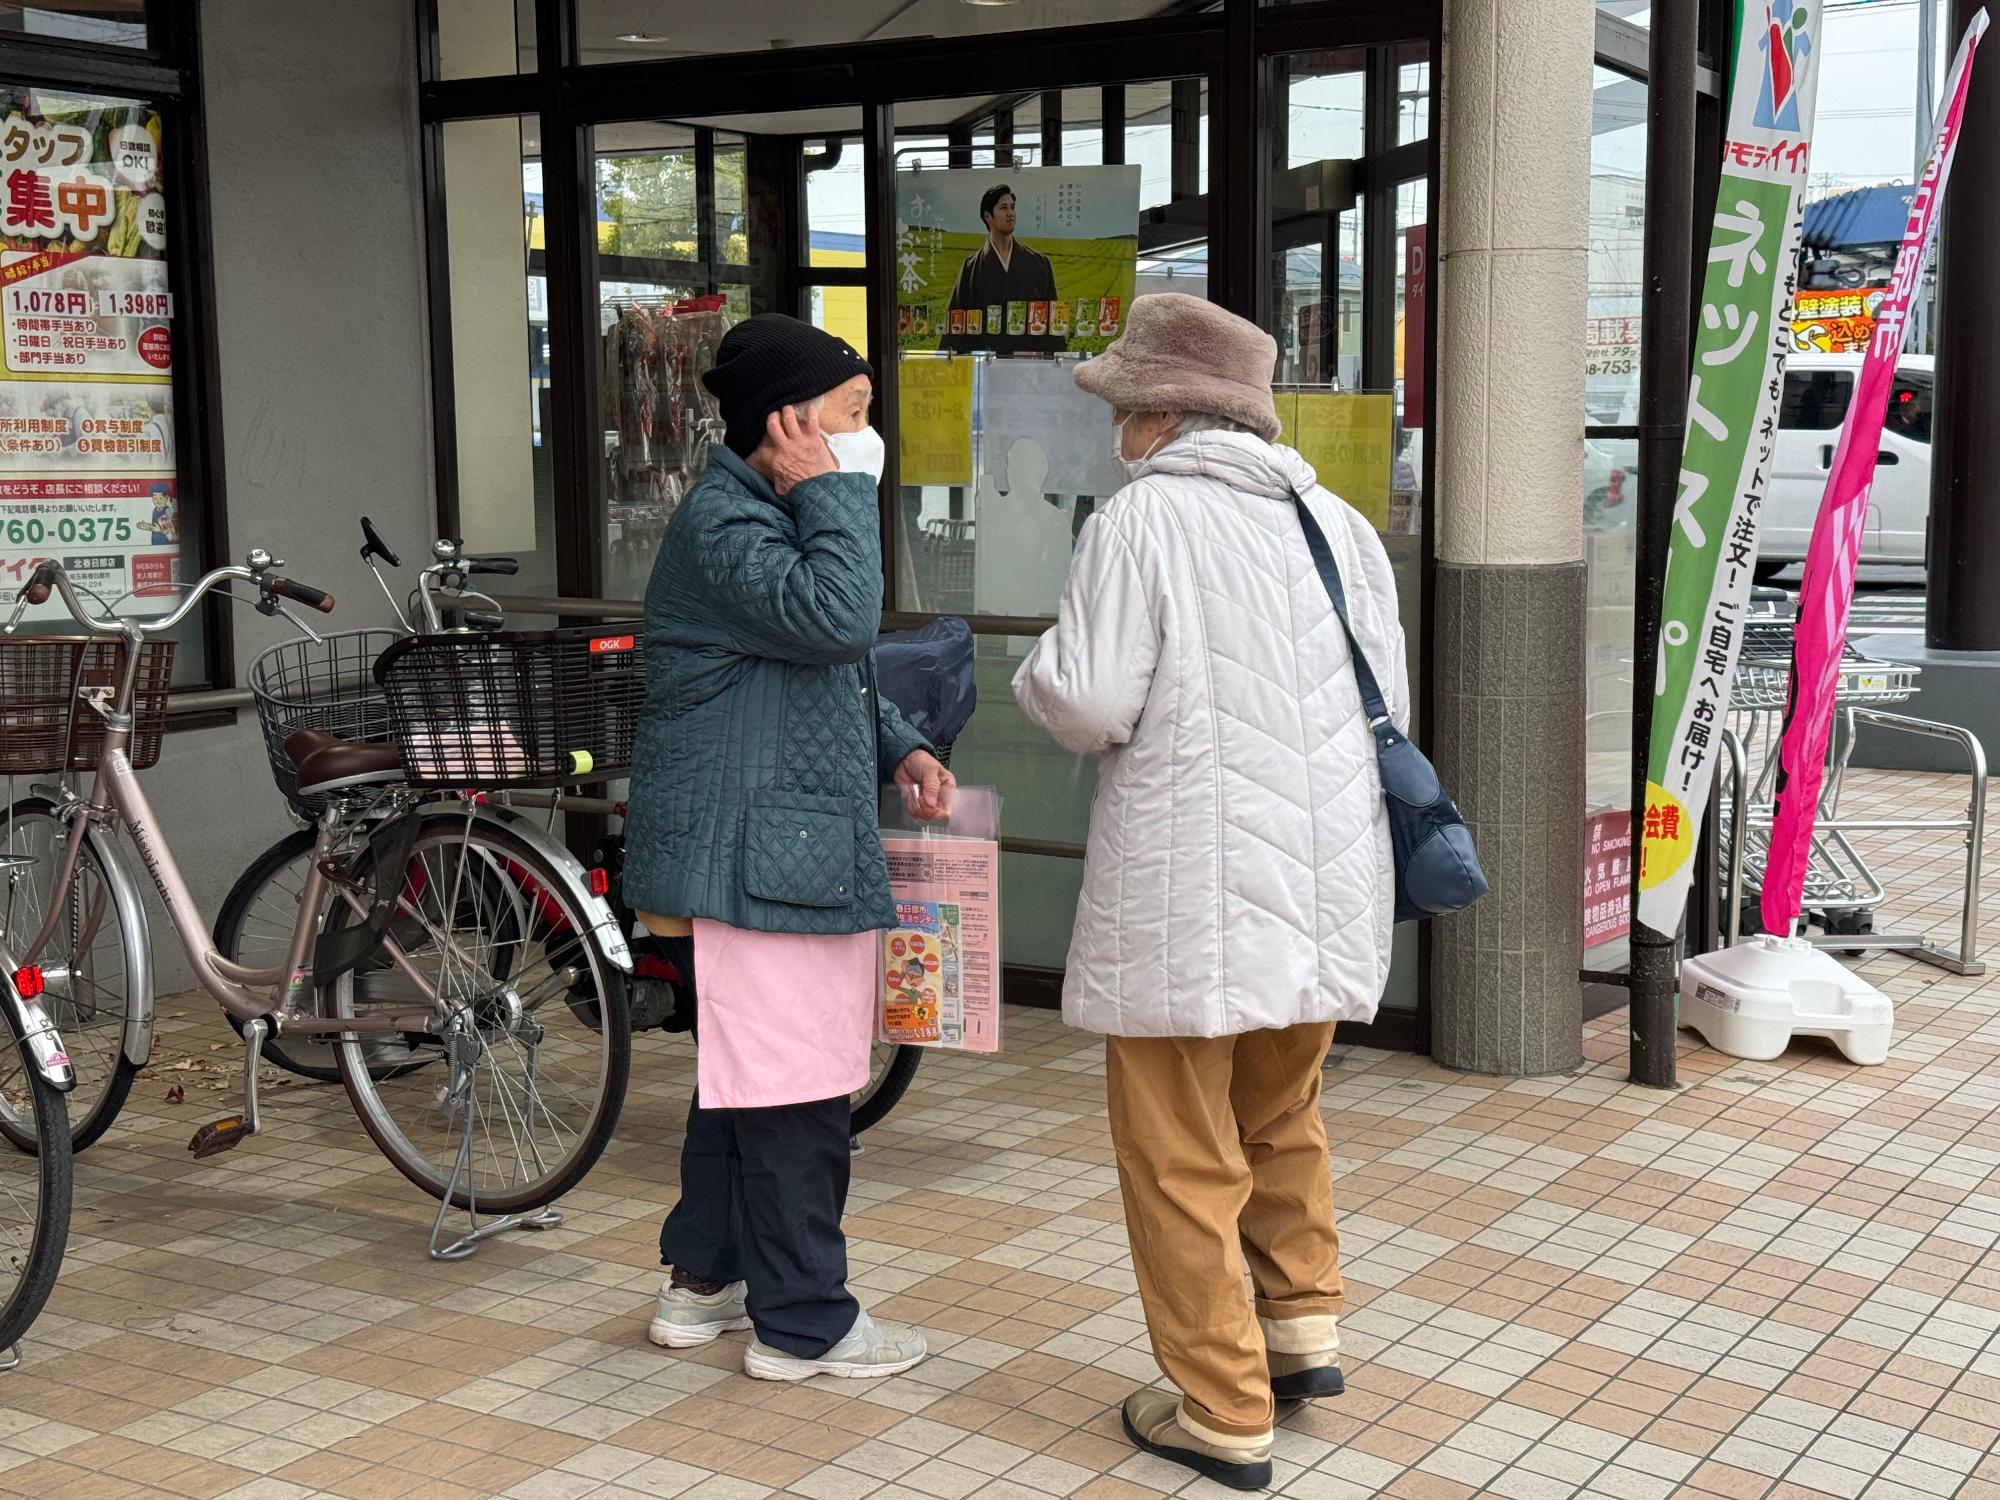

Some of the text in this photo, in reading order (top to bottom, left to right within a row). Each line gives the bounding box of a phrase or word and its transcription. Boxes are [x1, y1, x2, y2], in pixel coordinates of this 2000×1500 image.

[122, 155, 149, 169] OK!
[13, 290, 87, 315] 1,078円
[109, 293, 169, 316] 1,398円
[1795, 296, 1862, 320] 壁塗装
[73, 557, 116, 569] 北春日部店
[600, 639, 620, 649] OGK
[1681, 601, 1740, 792] ご自宅へお届け!
[1643, 803, 1680, 840] 会費
[1591, 842, 1601, 855] NO
[1584, 885, 1592, 898] NO
[1595, 880, 1611, 895] OPEN
[896, 908, 937, 924] 生活センター
[1586, 916, 1617, 939] DANGEROUS
